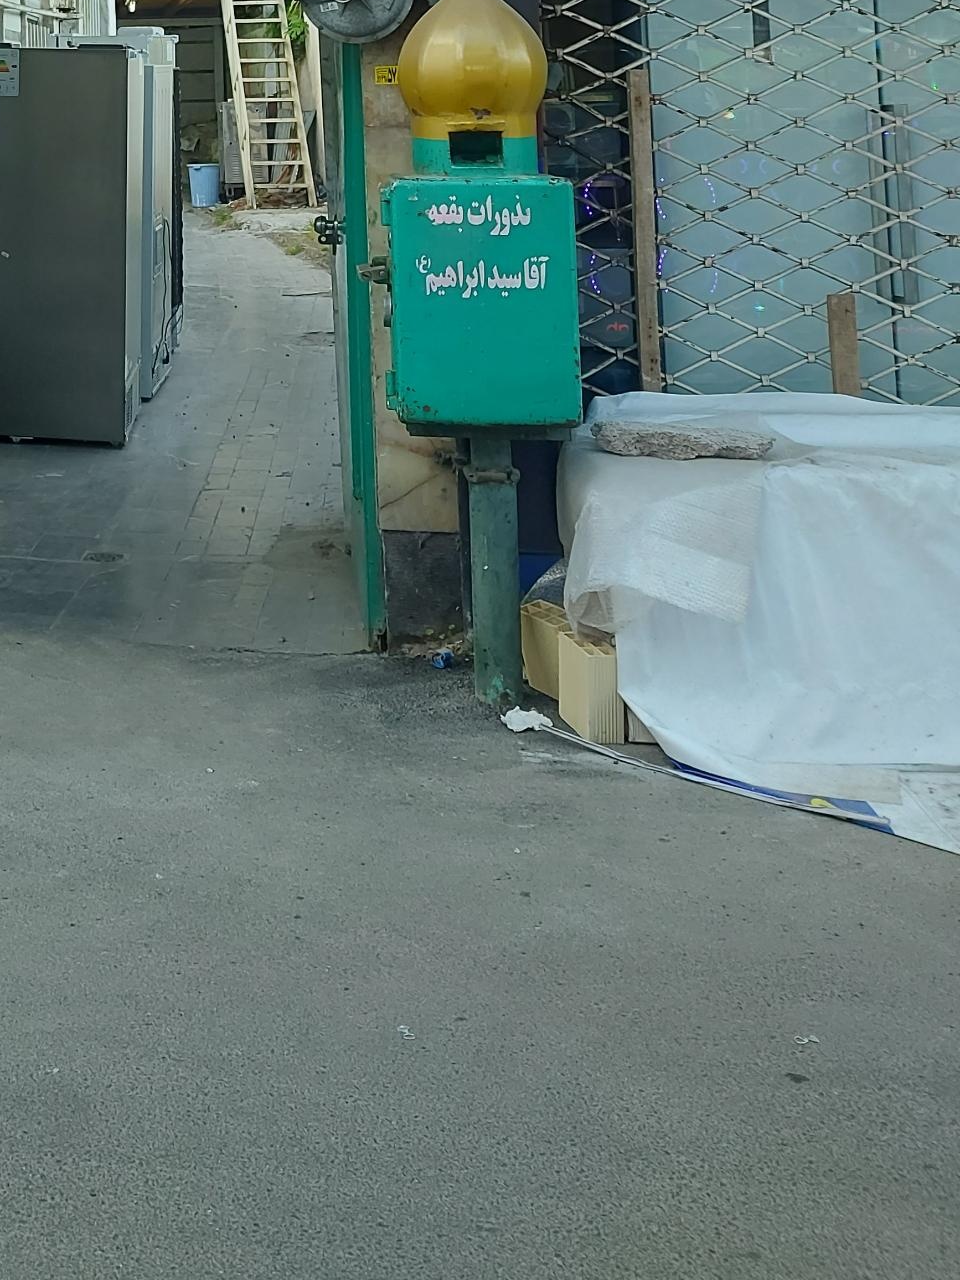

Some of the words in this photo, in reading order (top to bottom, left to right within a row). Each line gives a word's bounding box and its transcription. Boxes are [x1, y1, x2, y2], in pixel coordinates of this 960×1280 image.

[467, 195, 532, 236] نذورات
[425, 260, 485, 299] ابراهیم
[487, 265, 522, 297] سید
[524, 256, 550, 290] آقا
